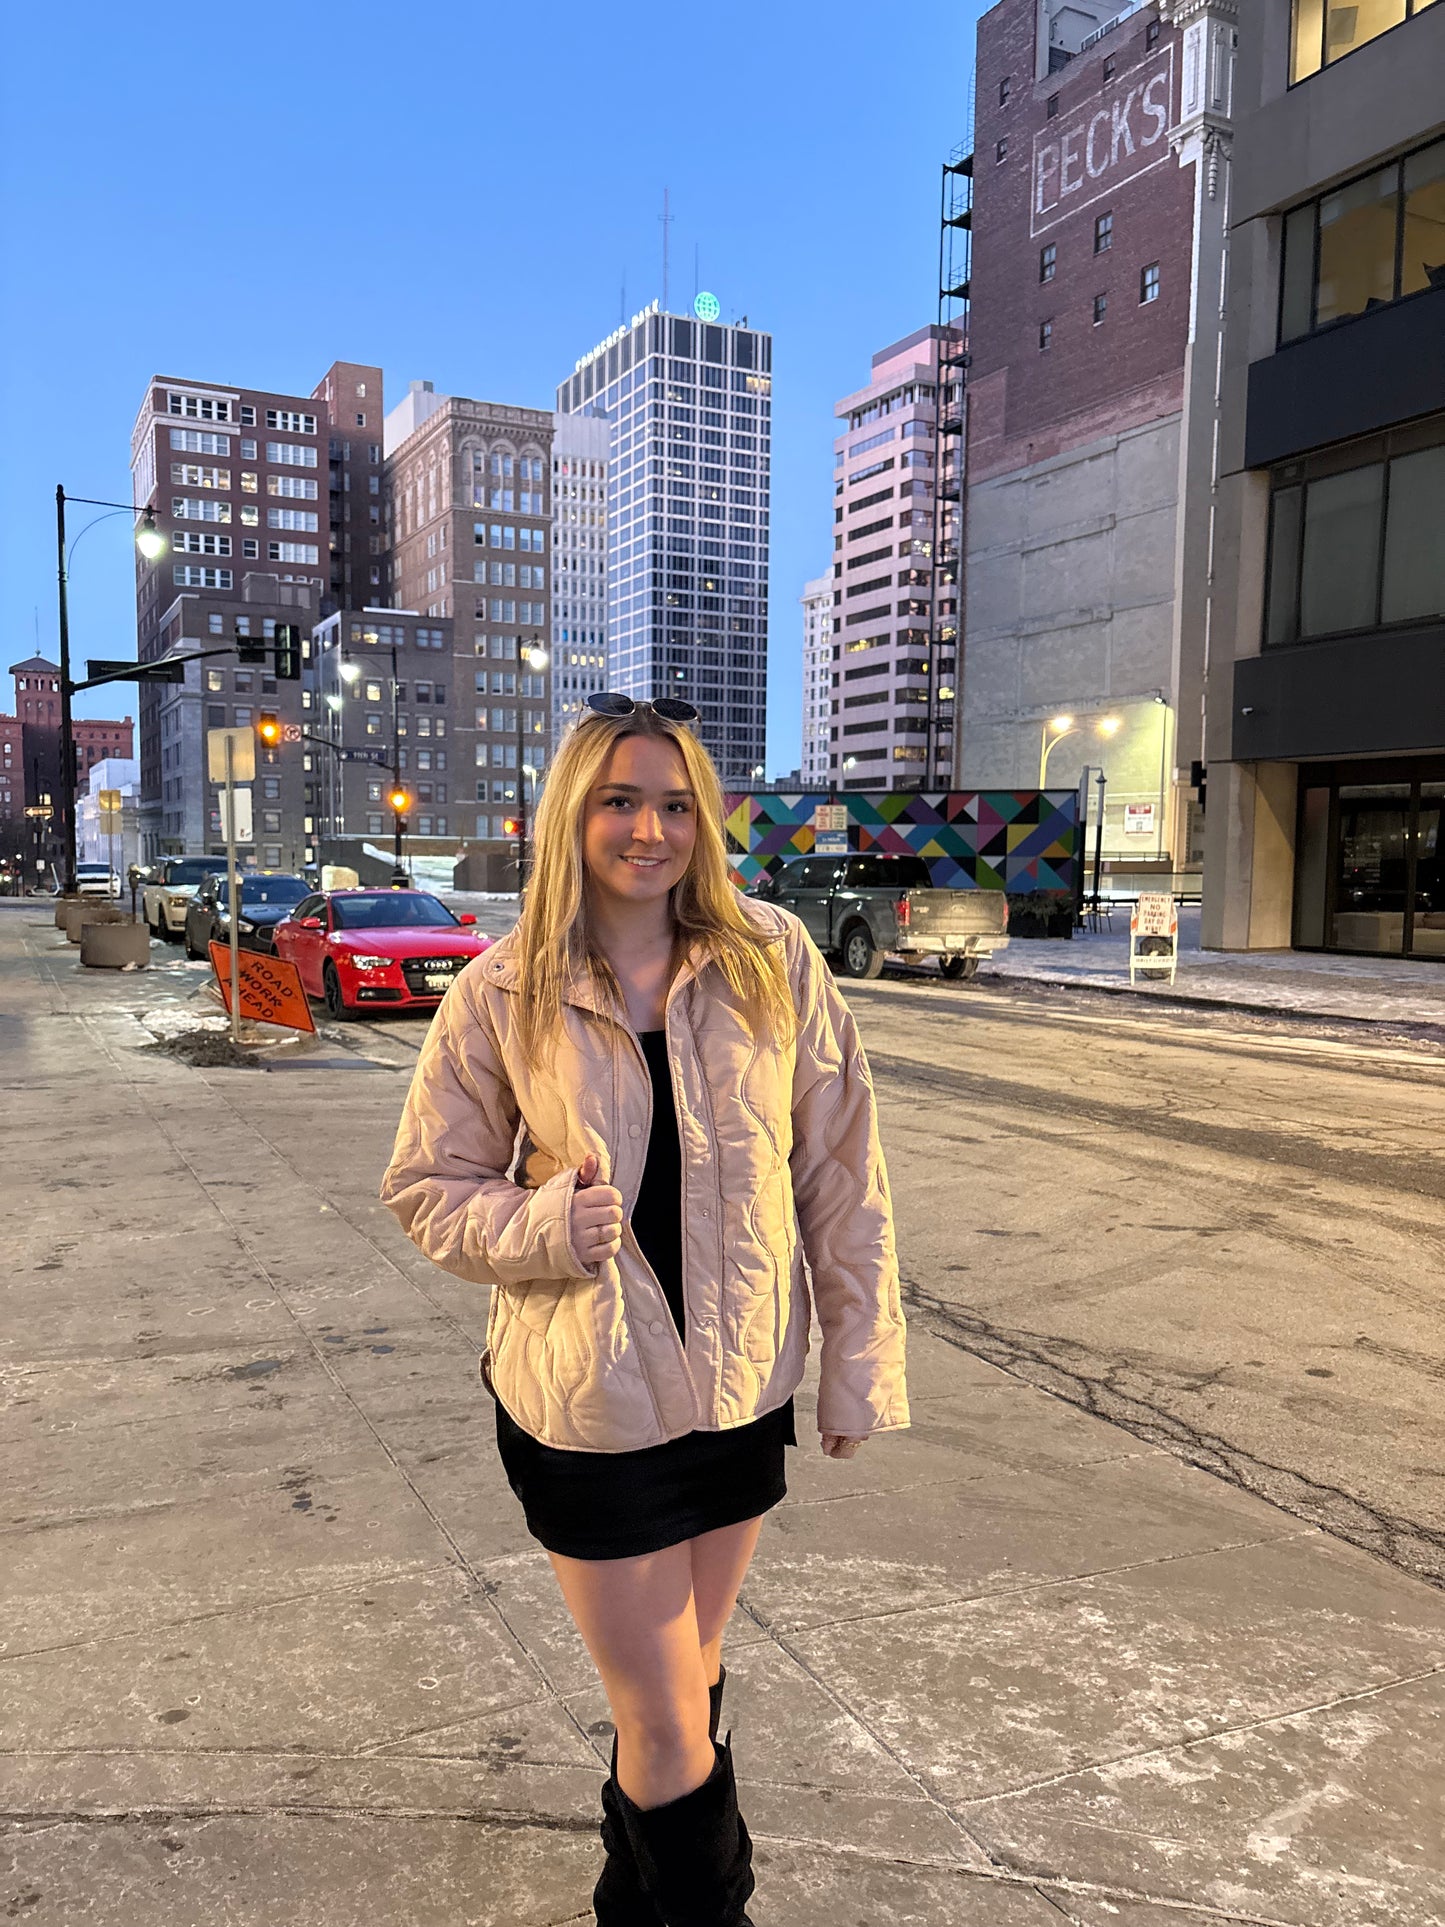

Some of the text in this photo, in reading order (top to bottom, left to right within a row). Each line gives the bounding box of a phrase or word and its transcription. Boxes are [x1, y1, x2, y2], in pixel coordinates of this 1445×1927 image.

[1036, 72, 1168, 214] PECK'S
[1150, 903, 1161, 911] NO
[239, 970, 282, 1007] WORK
[251, 961, 293, 998] ROAD
